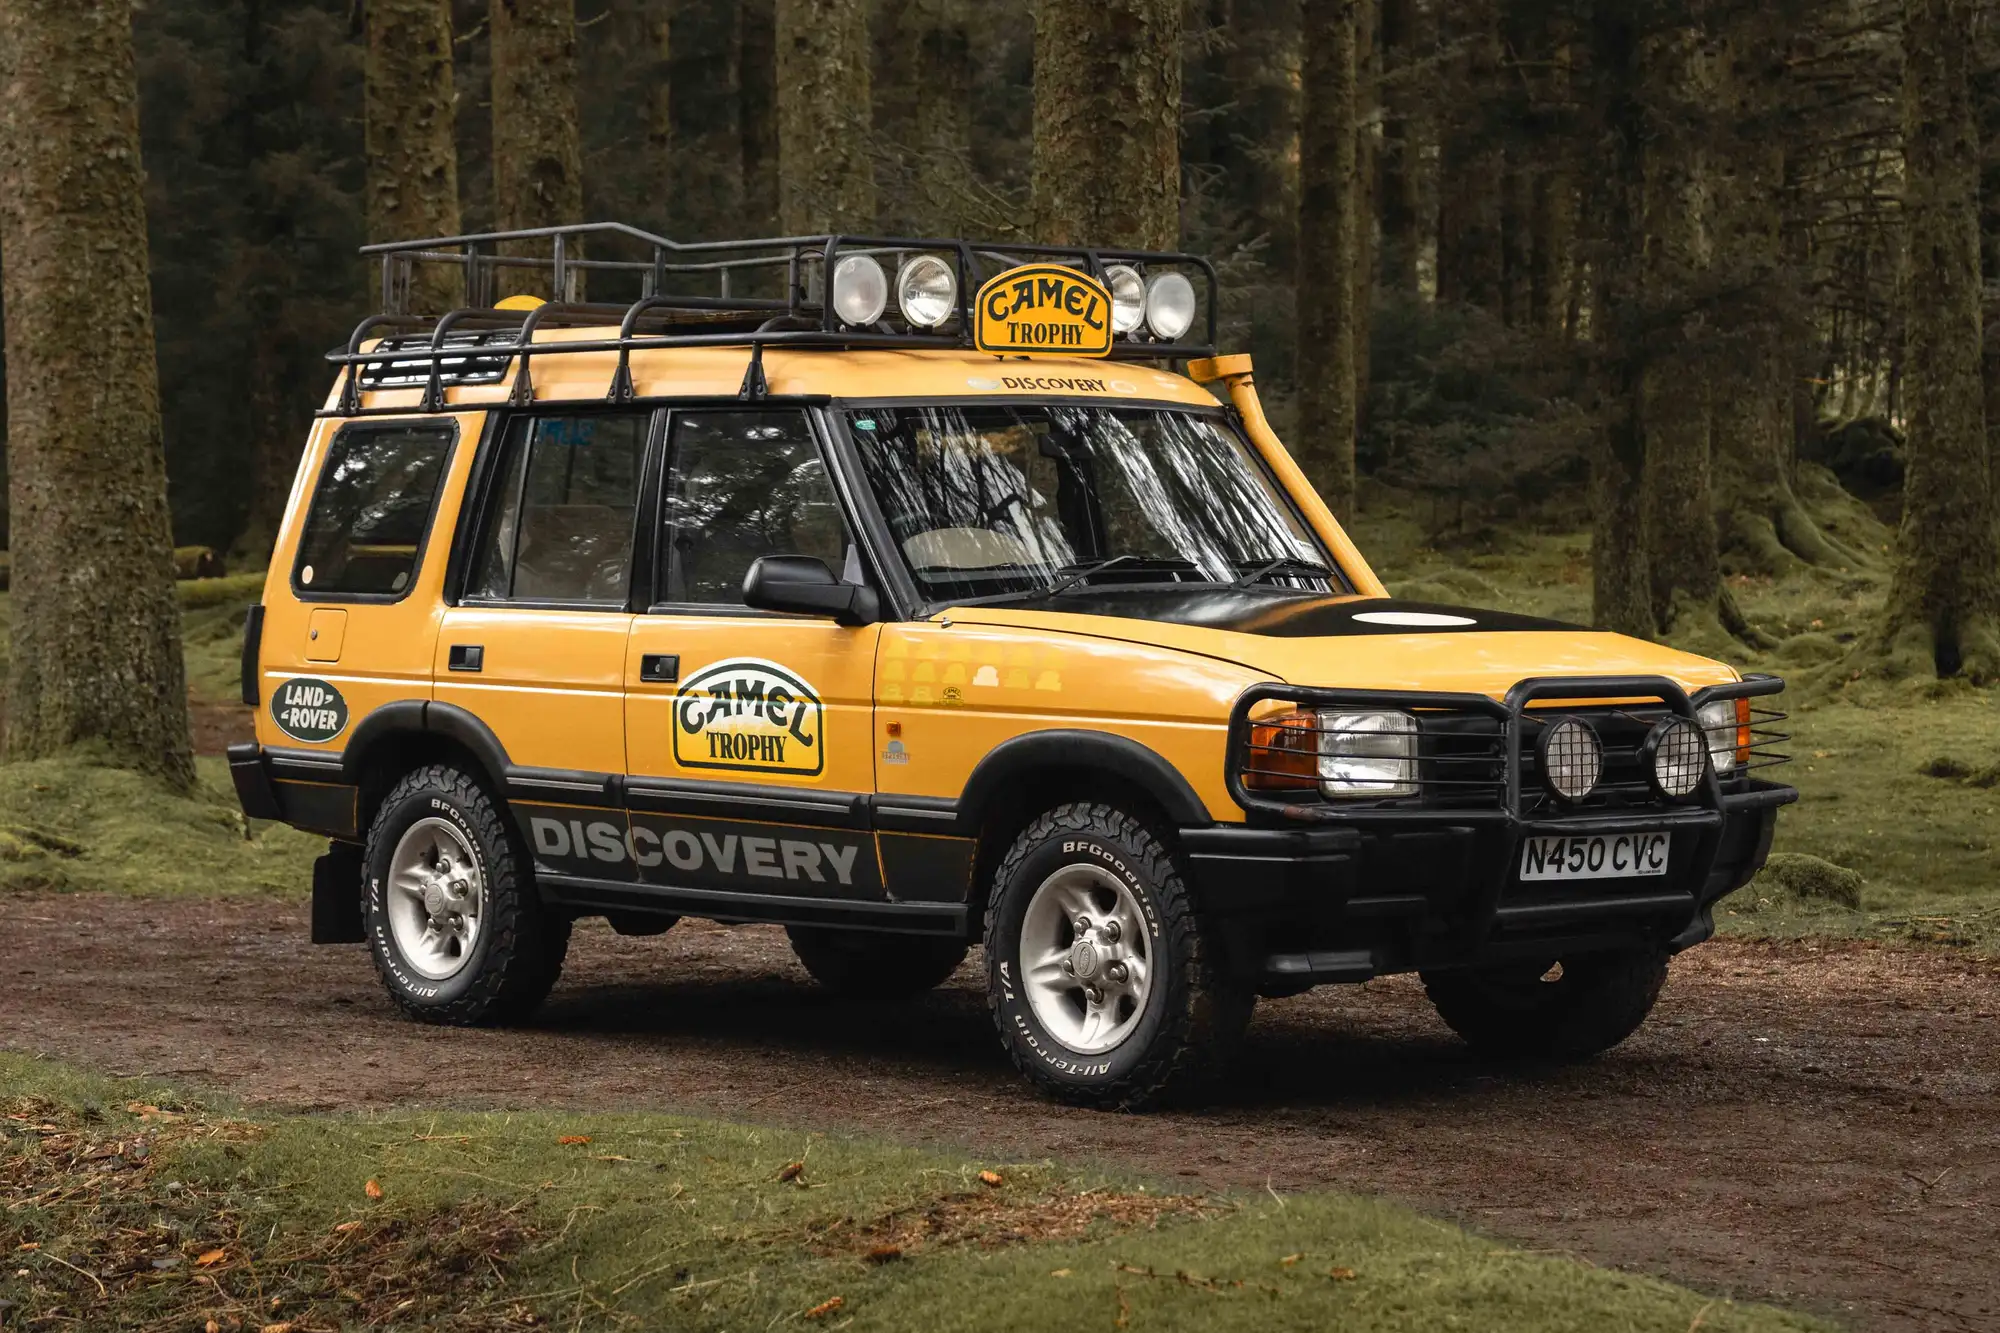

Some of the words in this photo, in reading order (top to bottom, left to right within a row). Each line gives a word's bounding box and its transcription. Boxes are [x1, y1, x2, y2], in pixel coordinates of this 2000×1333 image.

[987, 278, 1103, 331] CAMEL
[1006, 321, 1085, 345] TROPHY
[1001, 377, 1107, 392] DISCOVERY
[284, 685, 325, 707] LAND
[679, 678, 814, 748] CAMEL
[289, 707, 338, 731] ROVER
[706, 730, 788, 763] TROPHY
[530, 816, 859, 885] DISCOVERY
[1525, 837, 1606, 874] N450
[1612, 834, 1666, 871] CVC
[1000, 961, 1015, 1003] T/A
[1014, 1014, 1113, 1077] All-Terrain
